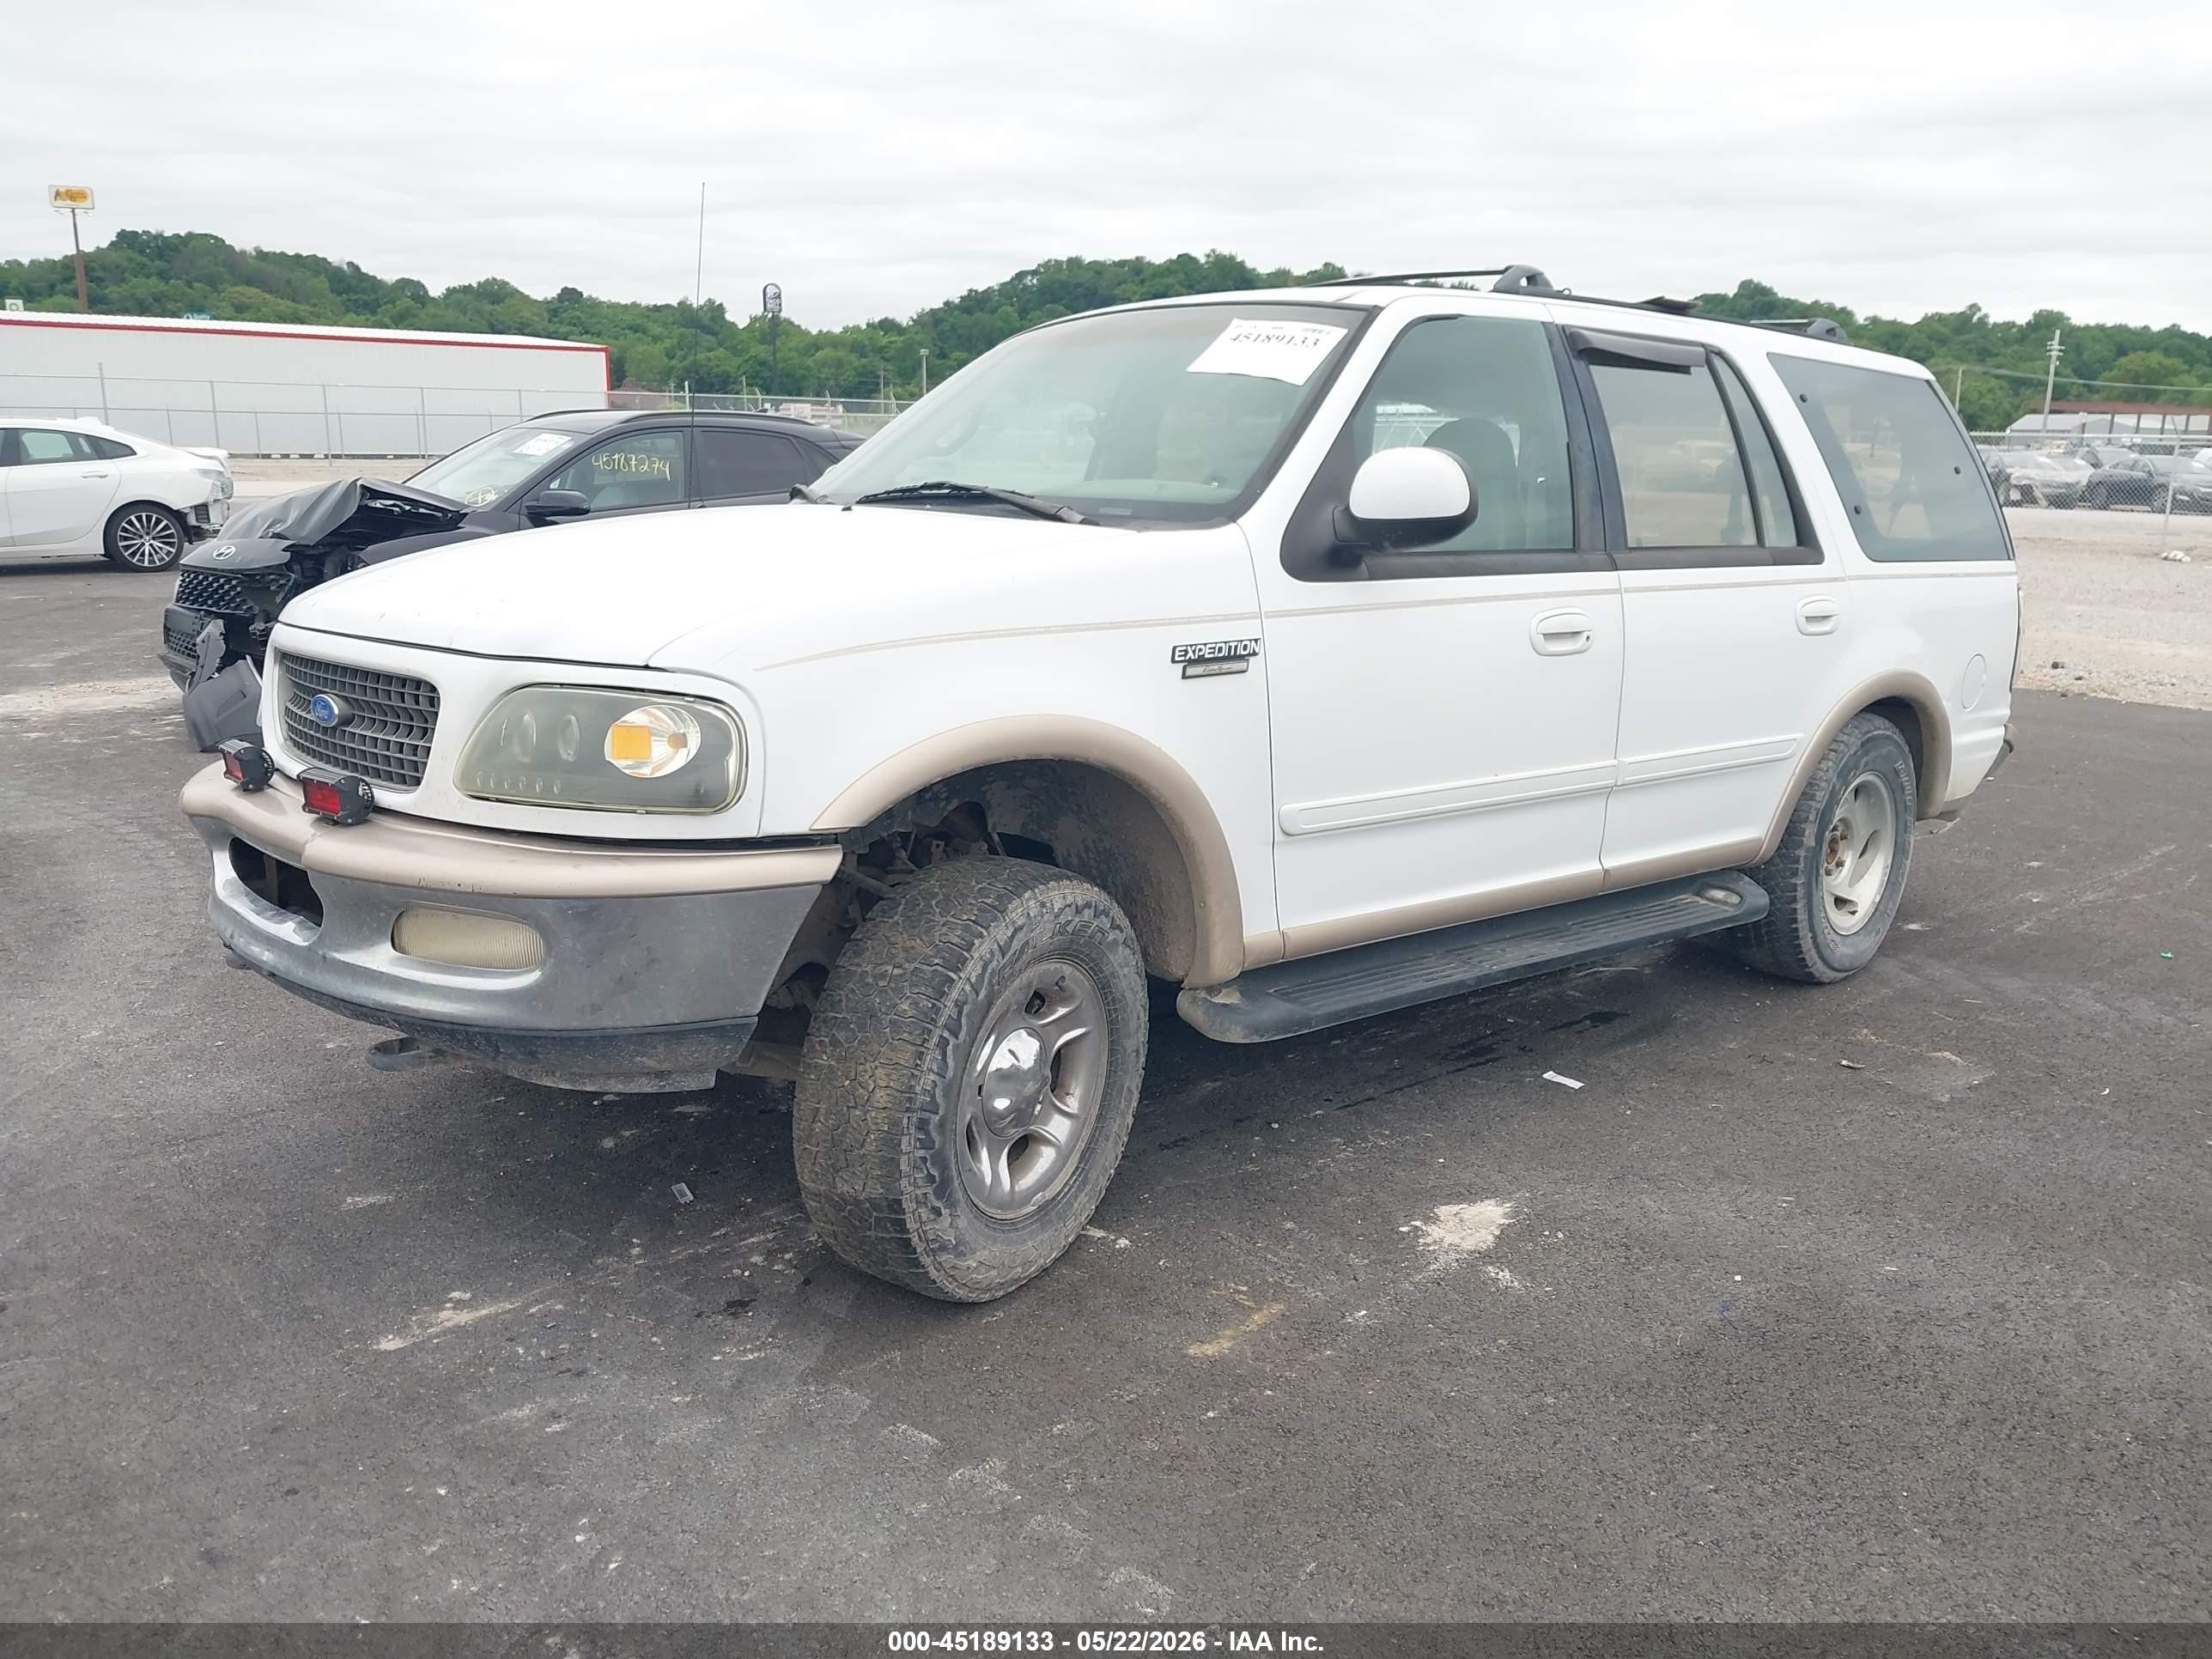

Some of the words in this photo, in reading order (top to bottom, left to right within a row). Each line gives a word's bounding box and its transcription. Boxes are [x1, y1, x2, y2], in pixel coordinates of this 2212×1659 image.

[1230, 332, 1320, 348] 45189133
[592, 453, 671, 482] 45187274
[1174, 640, 1261, 661] EXPEDITION
